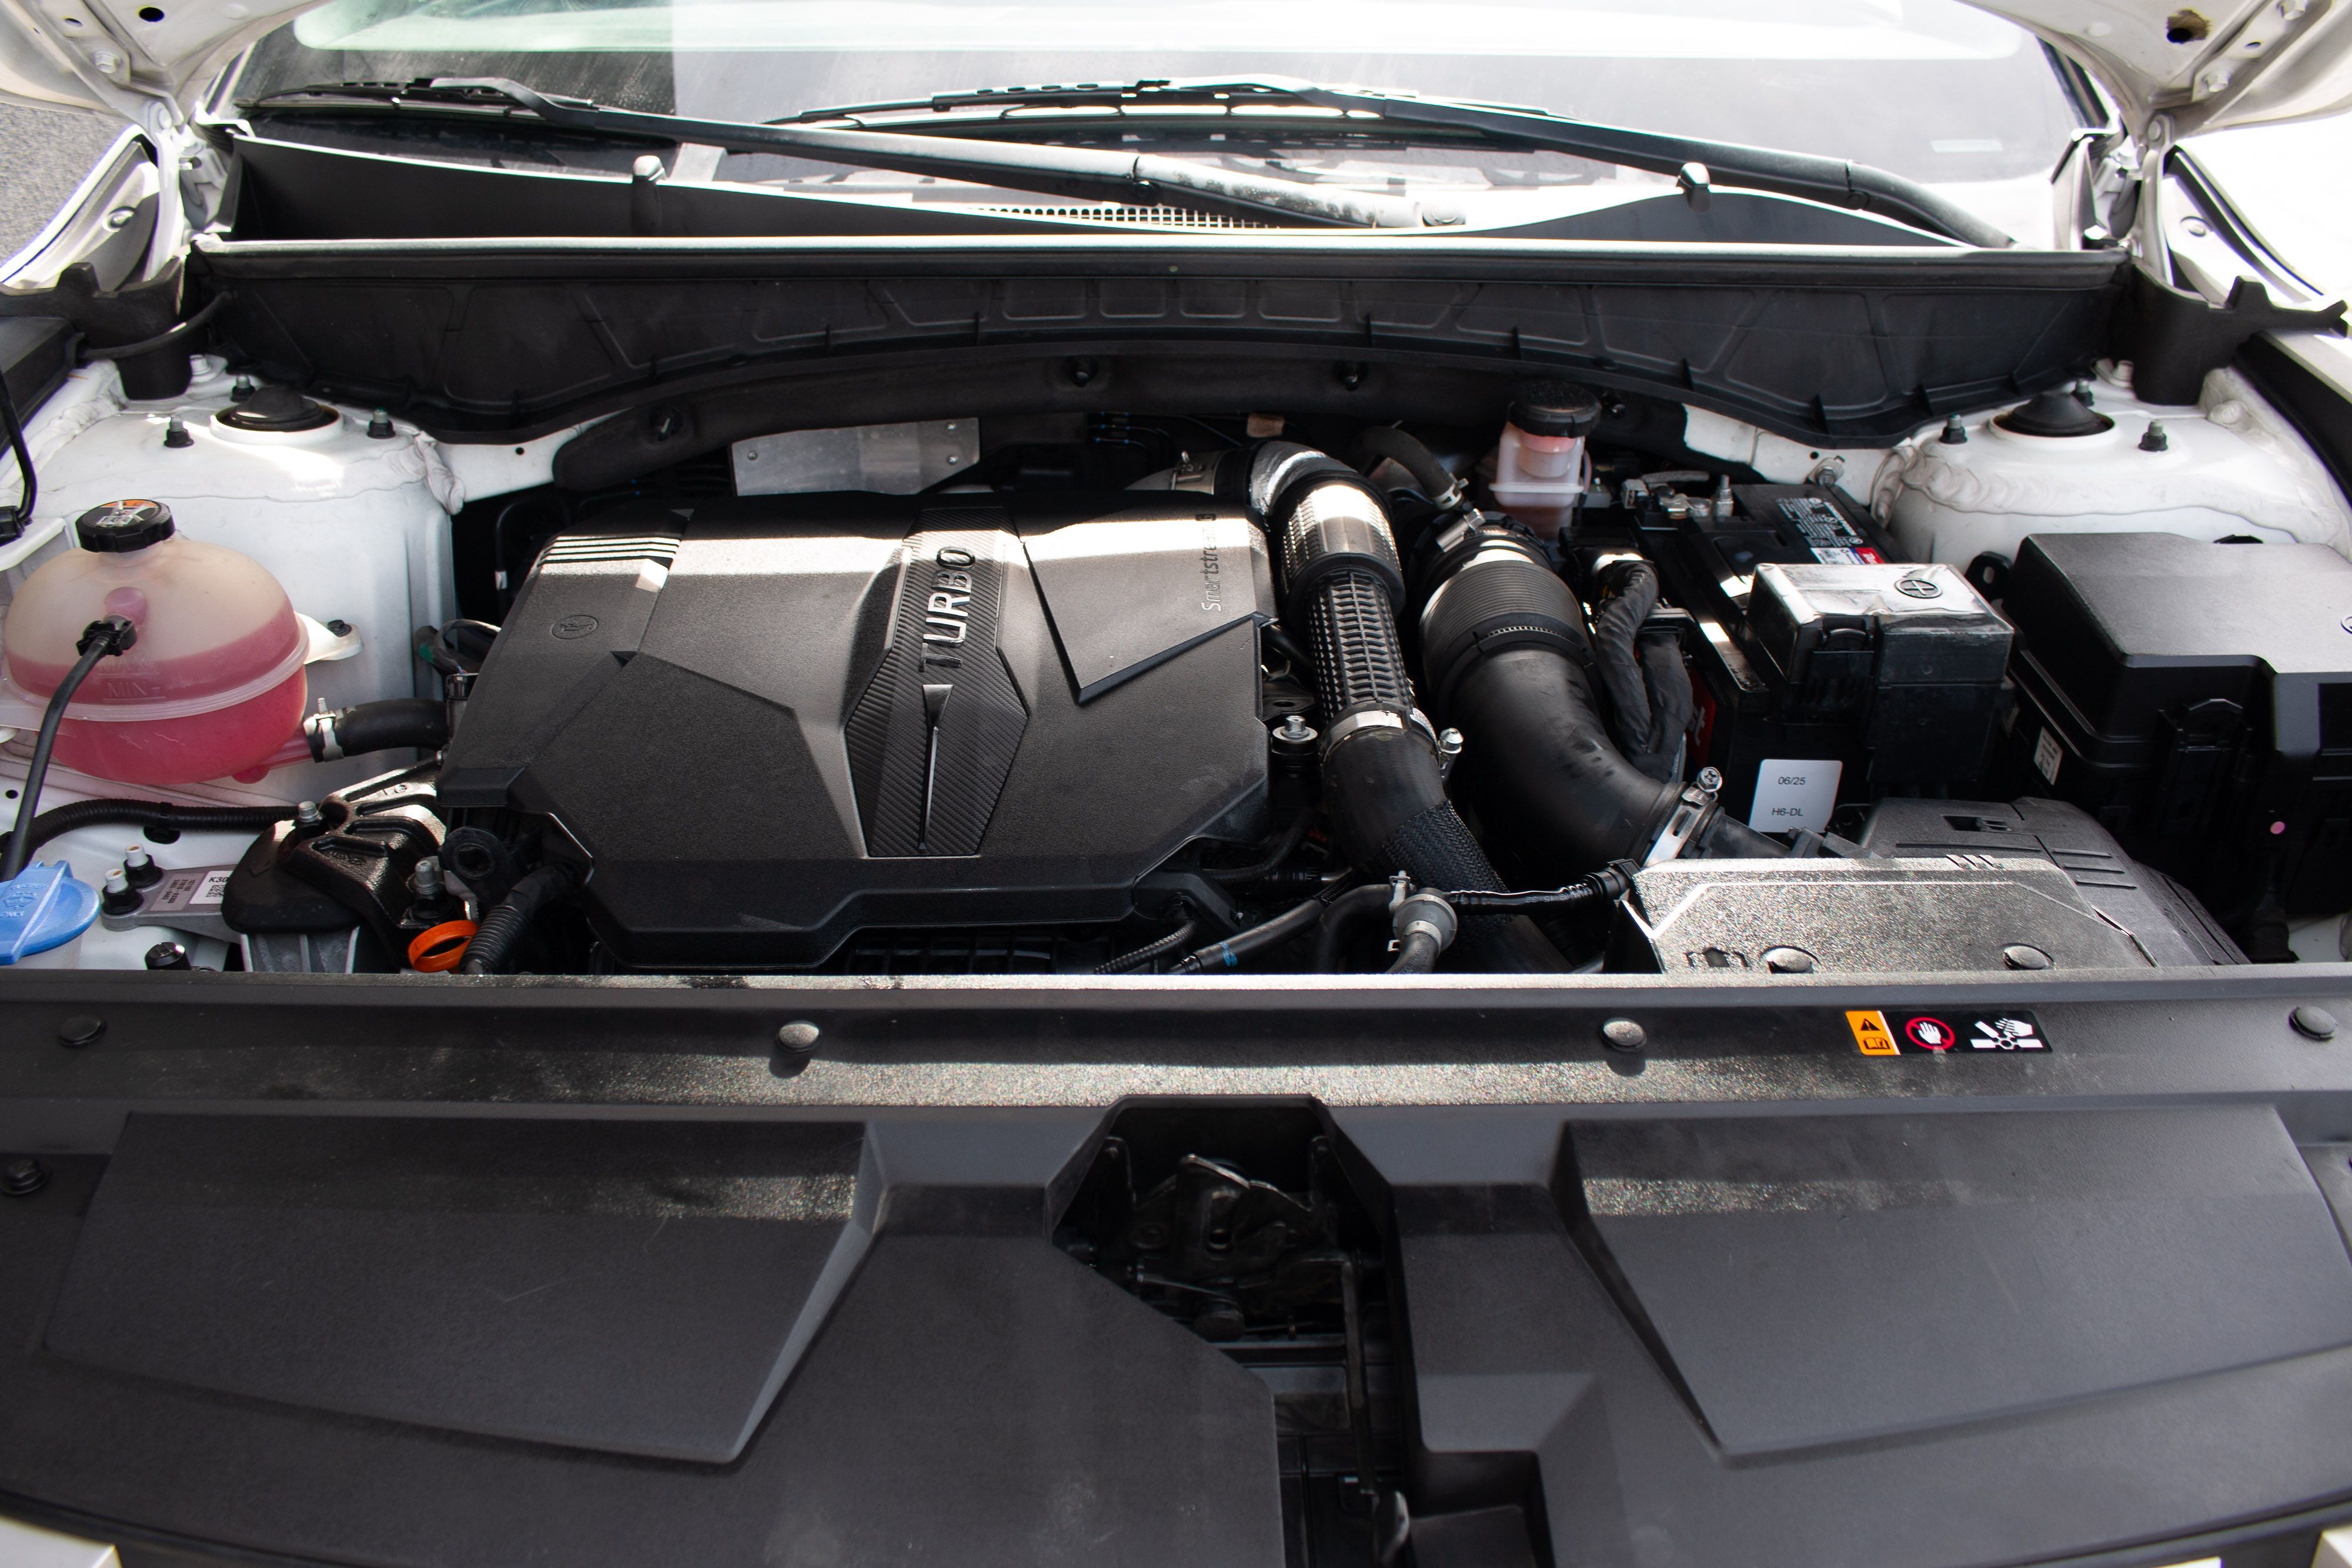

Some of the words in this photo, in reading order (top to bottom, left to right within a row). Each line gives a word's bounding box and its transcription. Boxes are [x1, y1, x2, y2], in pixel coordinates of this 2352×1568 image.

[918, 546, 976, 673] TURBO
[1778, 777, 1806, 785] 06/25
[1772, 808, 1804, 817] H6-DL
